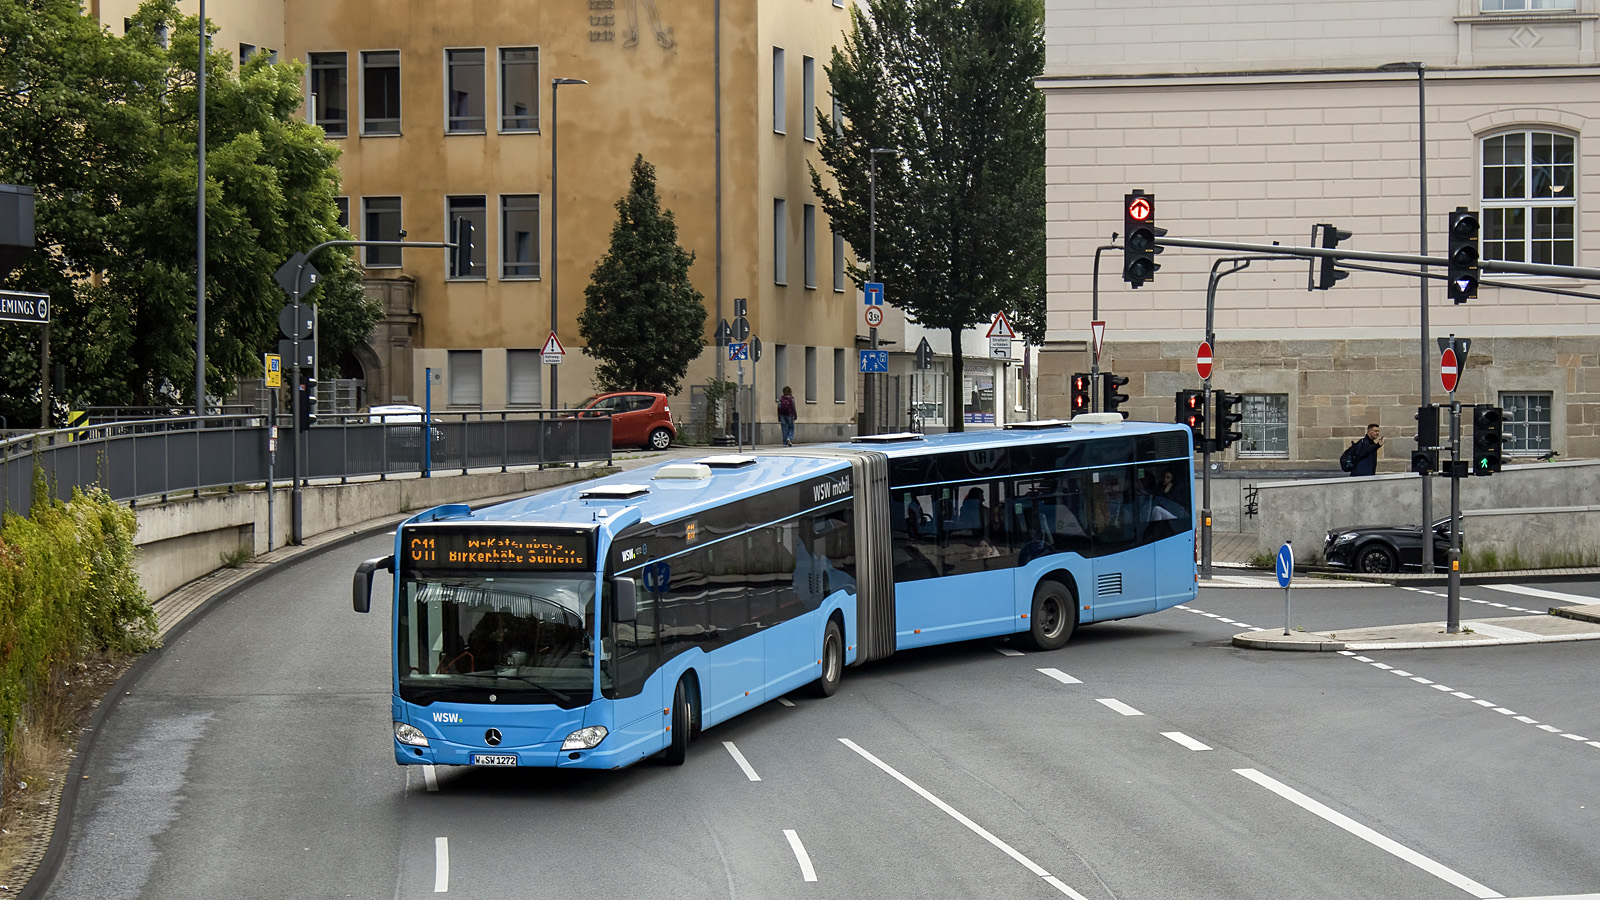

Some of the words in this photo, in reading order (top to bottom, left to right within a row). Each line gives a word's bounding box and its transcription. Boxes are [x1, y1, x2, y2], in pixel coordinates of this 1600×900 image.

[0, 299, 35, 315] EMINGS
[813, 481, 831, 502] WSW
[832, 474, 850, 496] mobil
[496, 756, 516, 765] 1272
